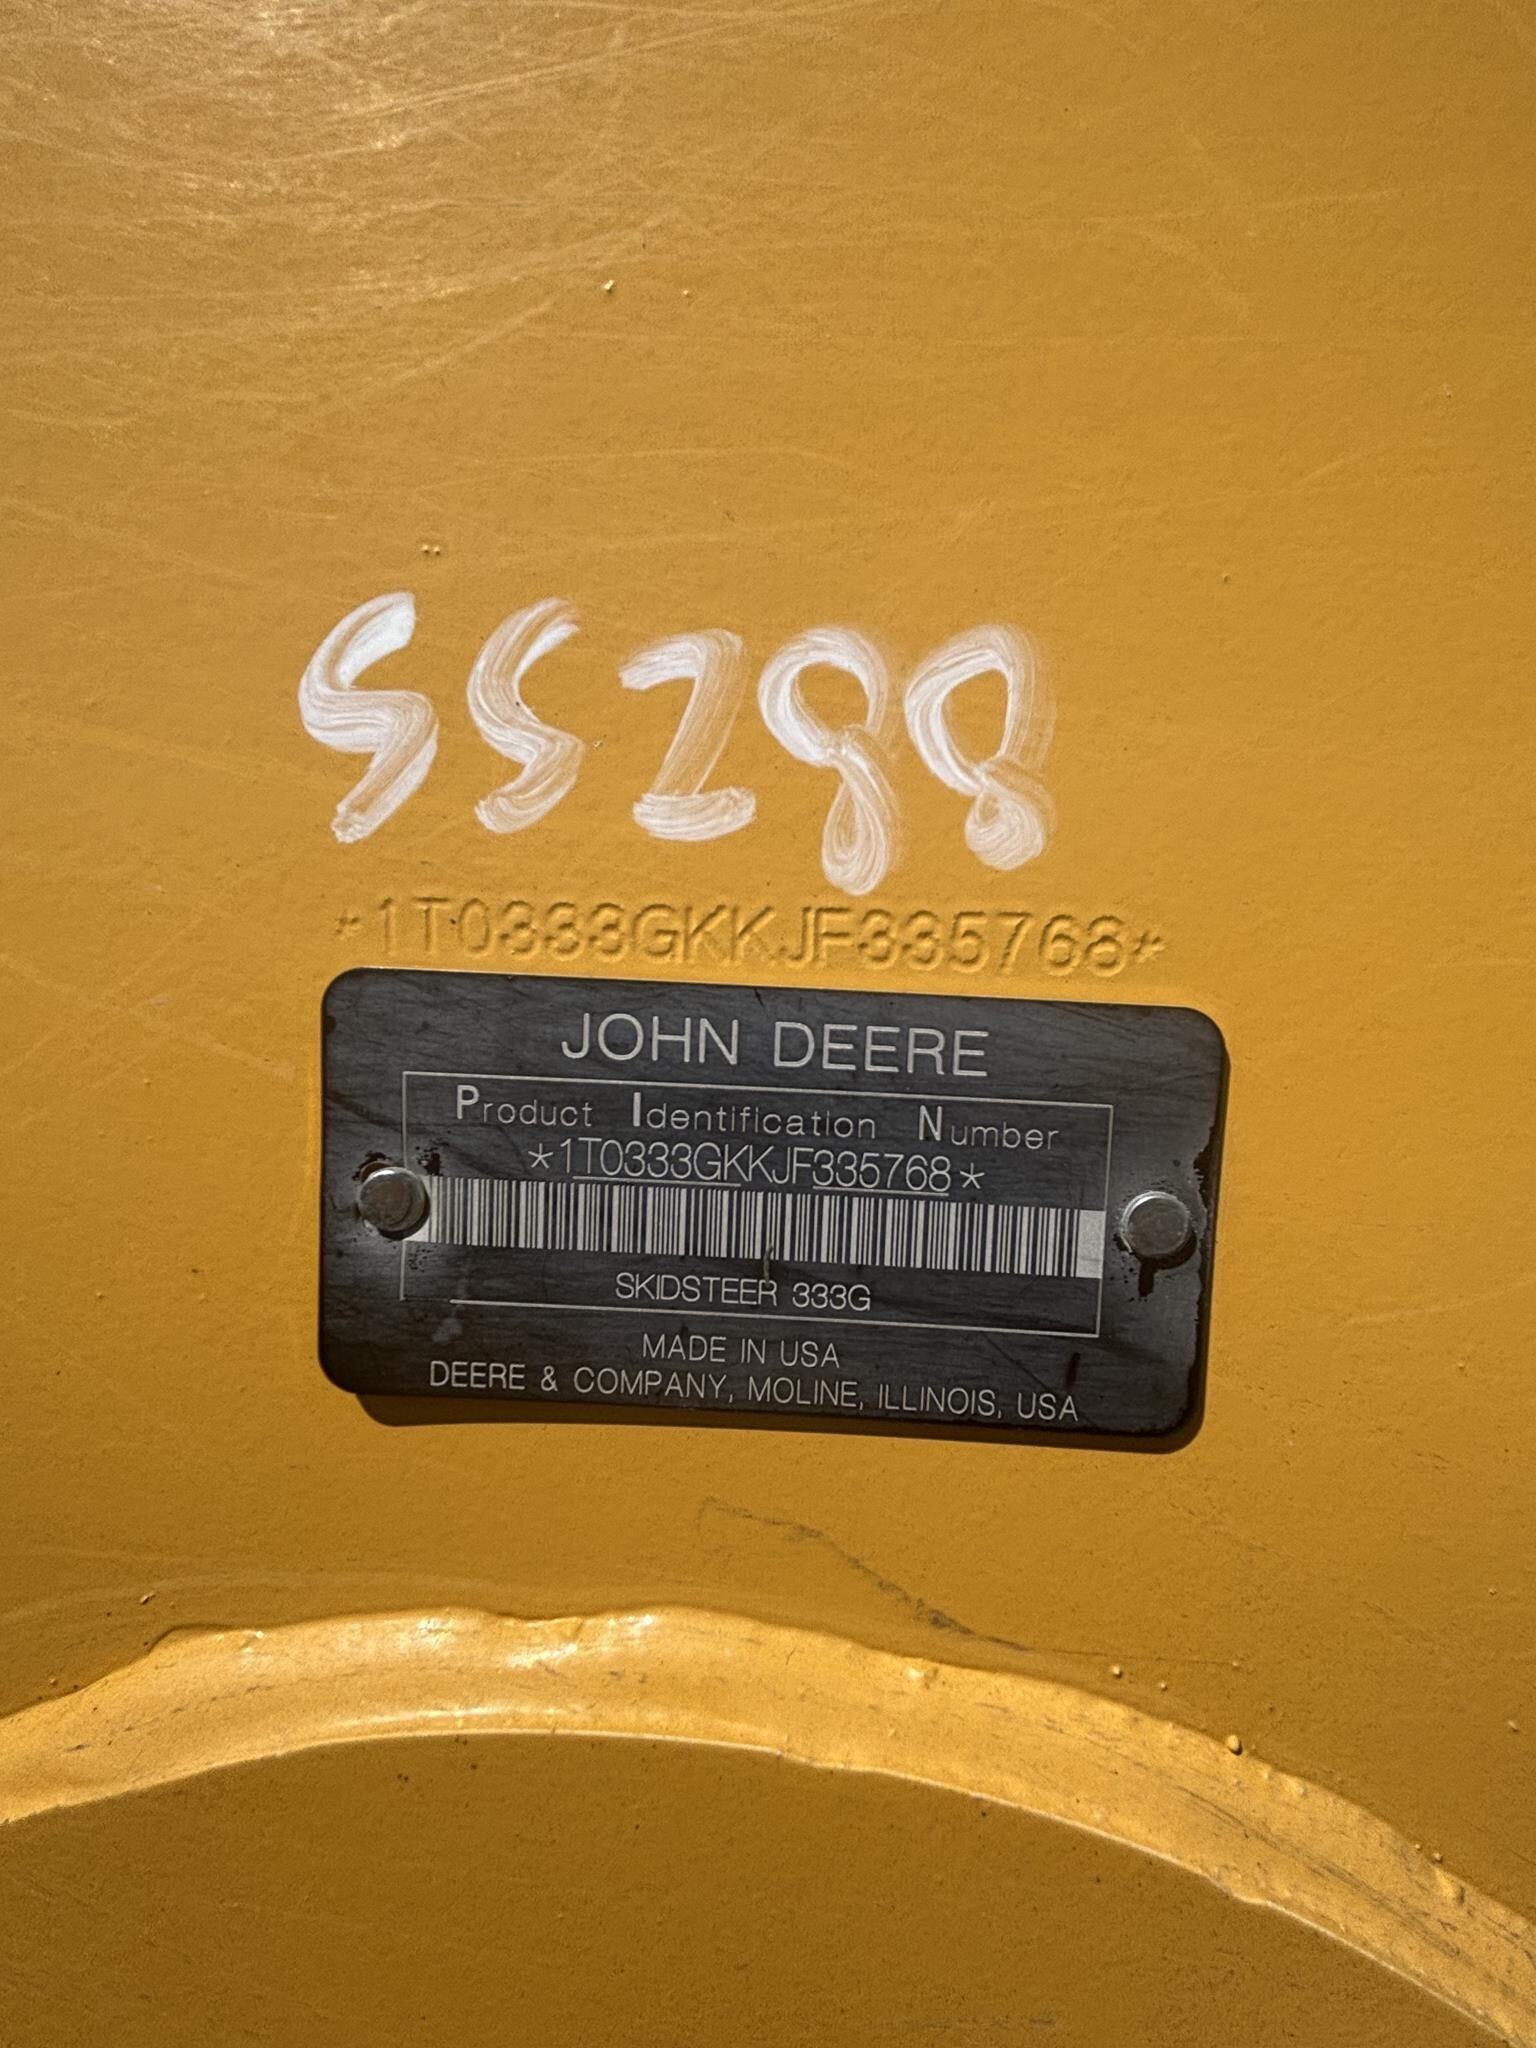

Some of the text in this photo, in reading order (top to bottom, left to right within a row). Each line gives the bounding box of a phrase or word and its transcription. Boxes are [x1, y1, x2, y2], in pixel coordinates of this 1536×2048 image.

[560, 1012, 990, 1077] JOHN DEERE
[456, 1084, 1060, 1150] Product Identification Number
[615, 1272, 871, 1312] SKIDSTEER 333G
[642, 1333, 840, 1368] MADE IN USA
[430, 1360, 1079, 1422] DEERE & COMPANY, MOLINE, ILLINOIS, USA
